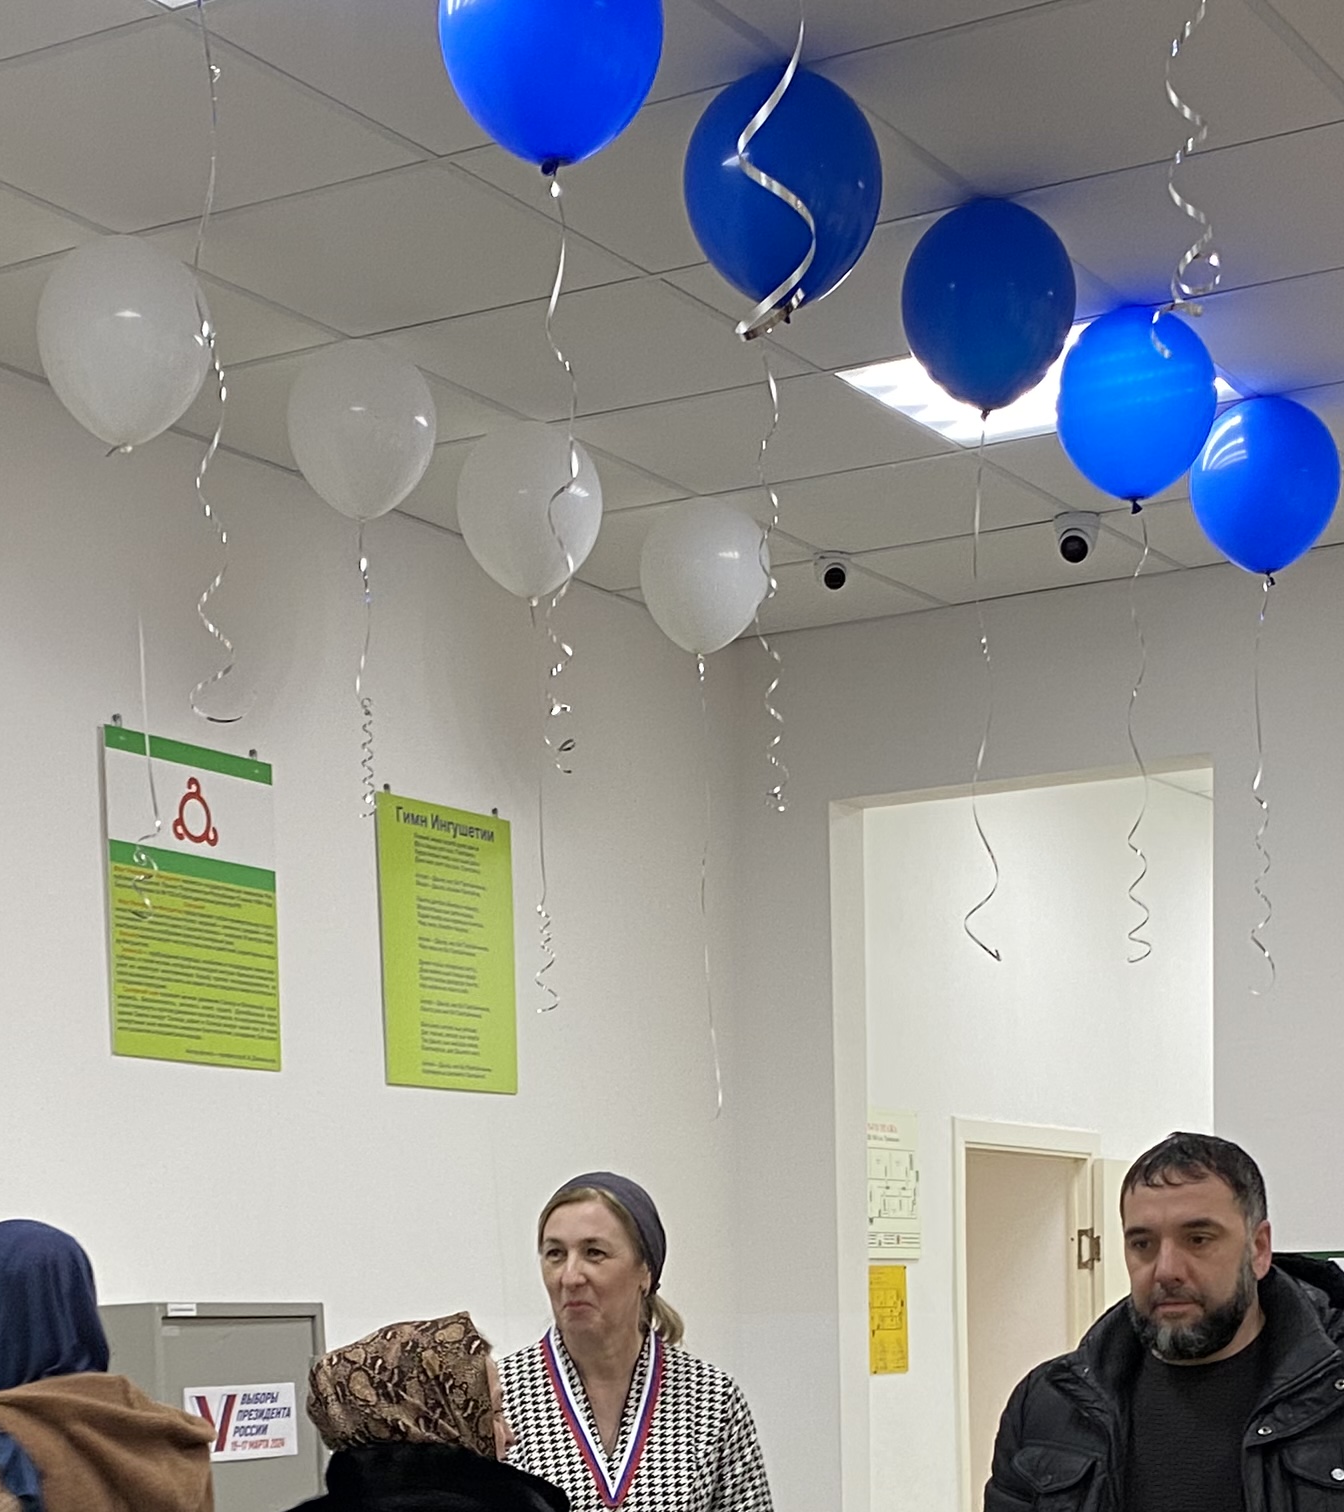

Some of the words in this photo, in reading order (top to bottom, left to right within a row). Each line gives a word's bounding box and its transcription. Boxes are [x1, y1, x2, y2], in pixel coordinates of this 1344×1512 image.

[396, 806, 427, 828] Гимн
[431, 814, 494, 842] Ингушетии
[240, 1392, 279, 1405] ВЫБОРЫ
[236, 1406, 291, 1421] ПРЕЗИДЕНТА
[232, 1424, 269, 1437] РОССИИ
